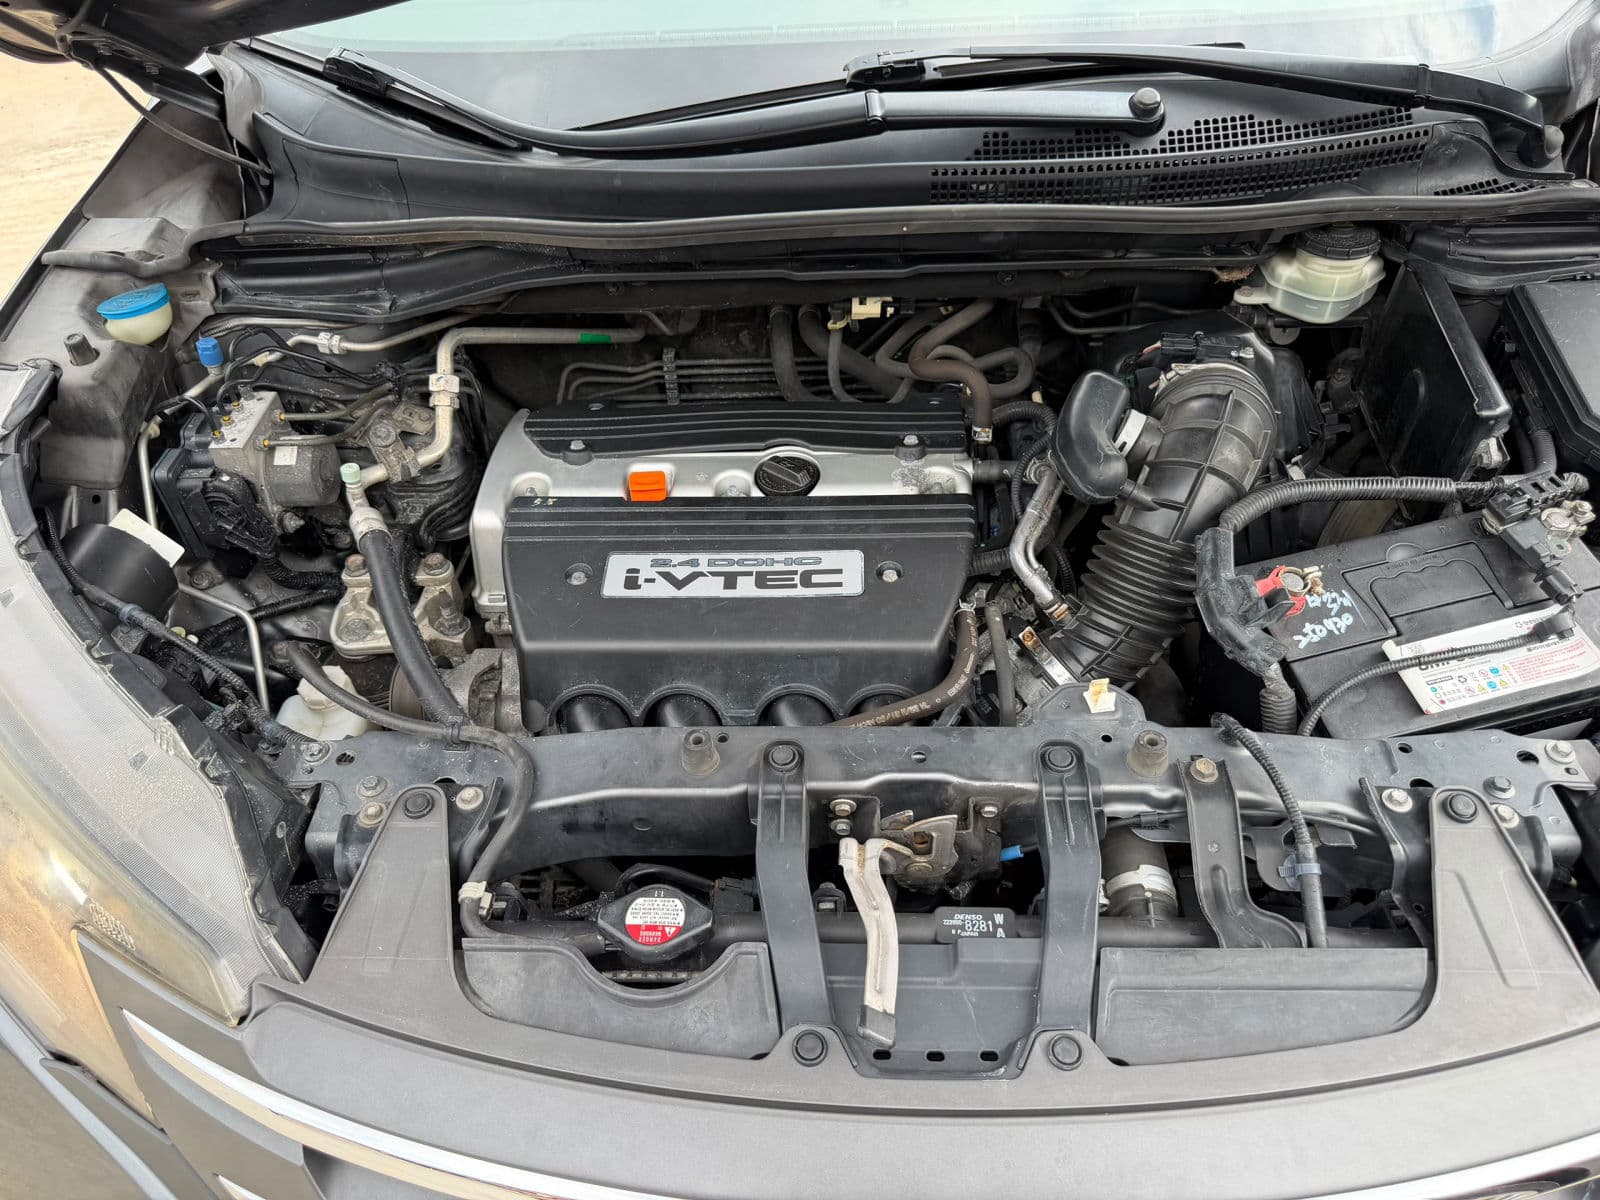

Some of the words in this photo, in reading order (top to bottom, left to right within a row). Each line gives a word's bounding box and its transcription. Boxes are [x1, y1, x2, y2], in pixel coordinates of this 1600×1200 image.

[650, 557, 701, 568] 2.4
[707, 556, 822, 567] DOHC
[623, 567, 844, 591] i-VTEC
[994, 913, 1004, 925] W
[965, 920, 993, 932] 8281
[997, 928, 1006, 938] A
